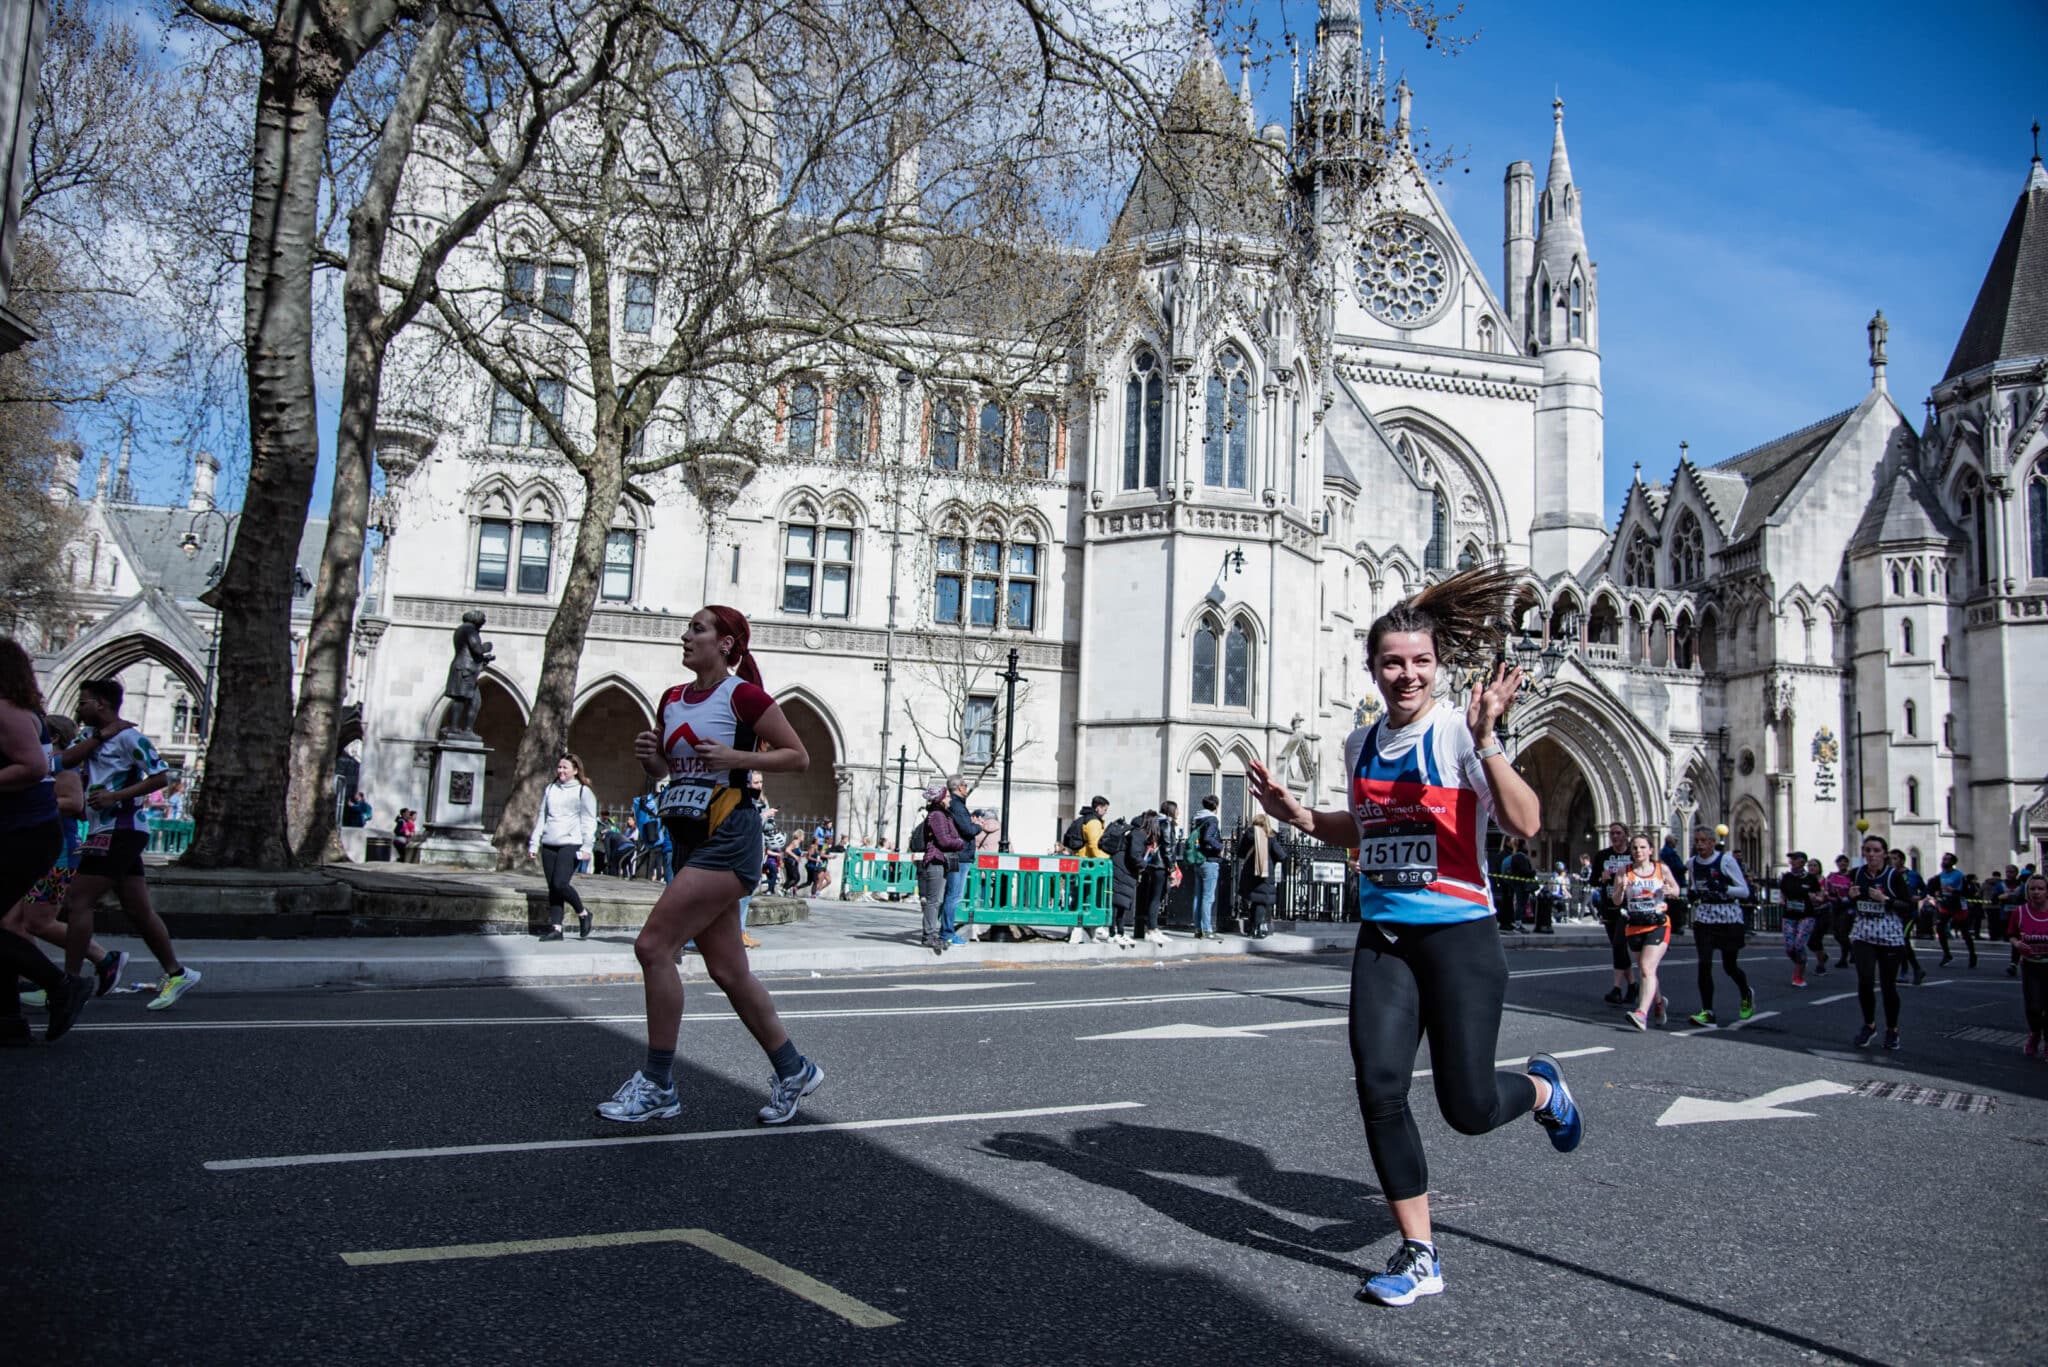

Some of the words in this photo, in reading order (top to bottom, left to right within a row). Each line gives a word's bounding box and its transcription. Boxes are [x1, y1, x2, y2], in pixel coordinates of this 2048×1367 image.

[665, 788, 707, 804] 14114
[1356, 798, 1384, 818] afa
[1415, 804, 1446, 814] Forces
[1364, 841, 1432, 865] 15170
